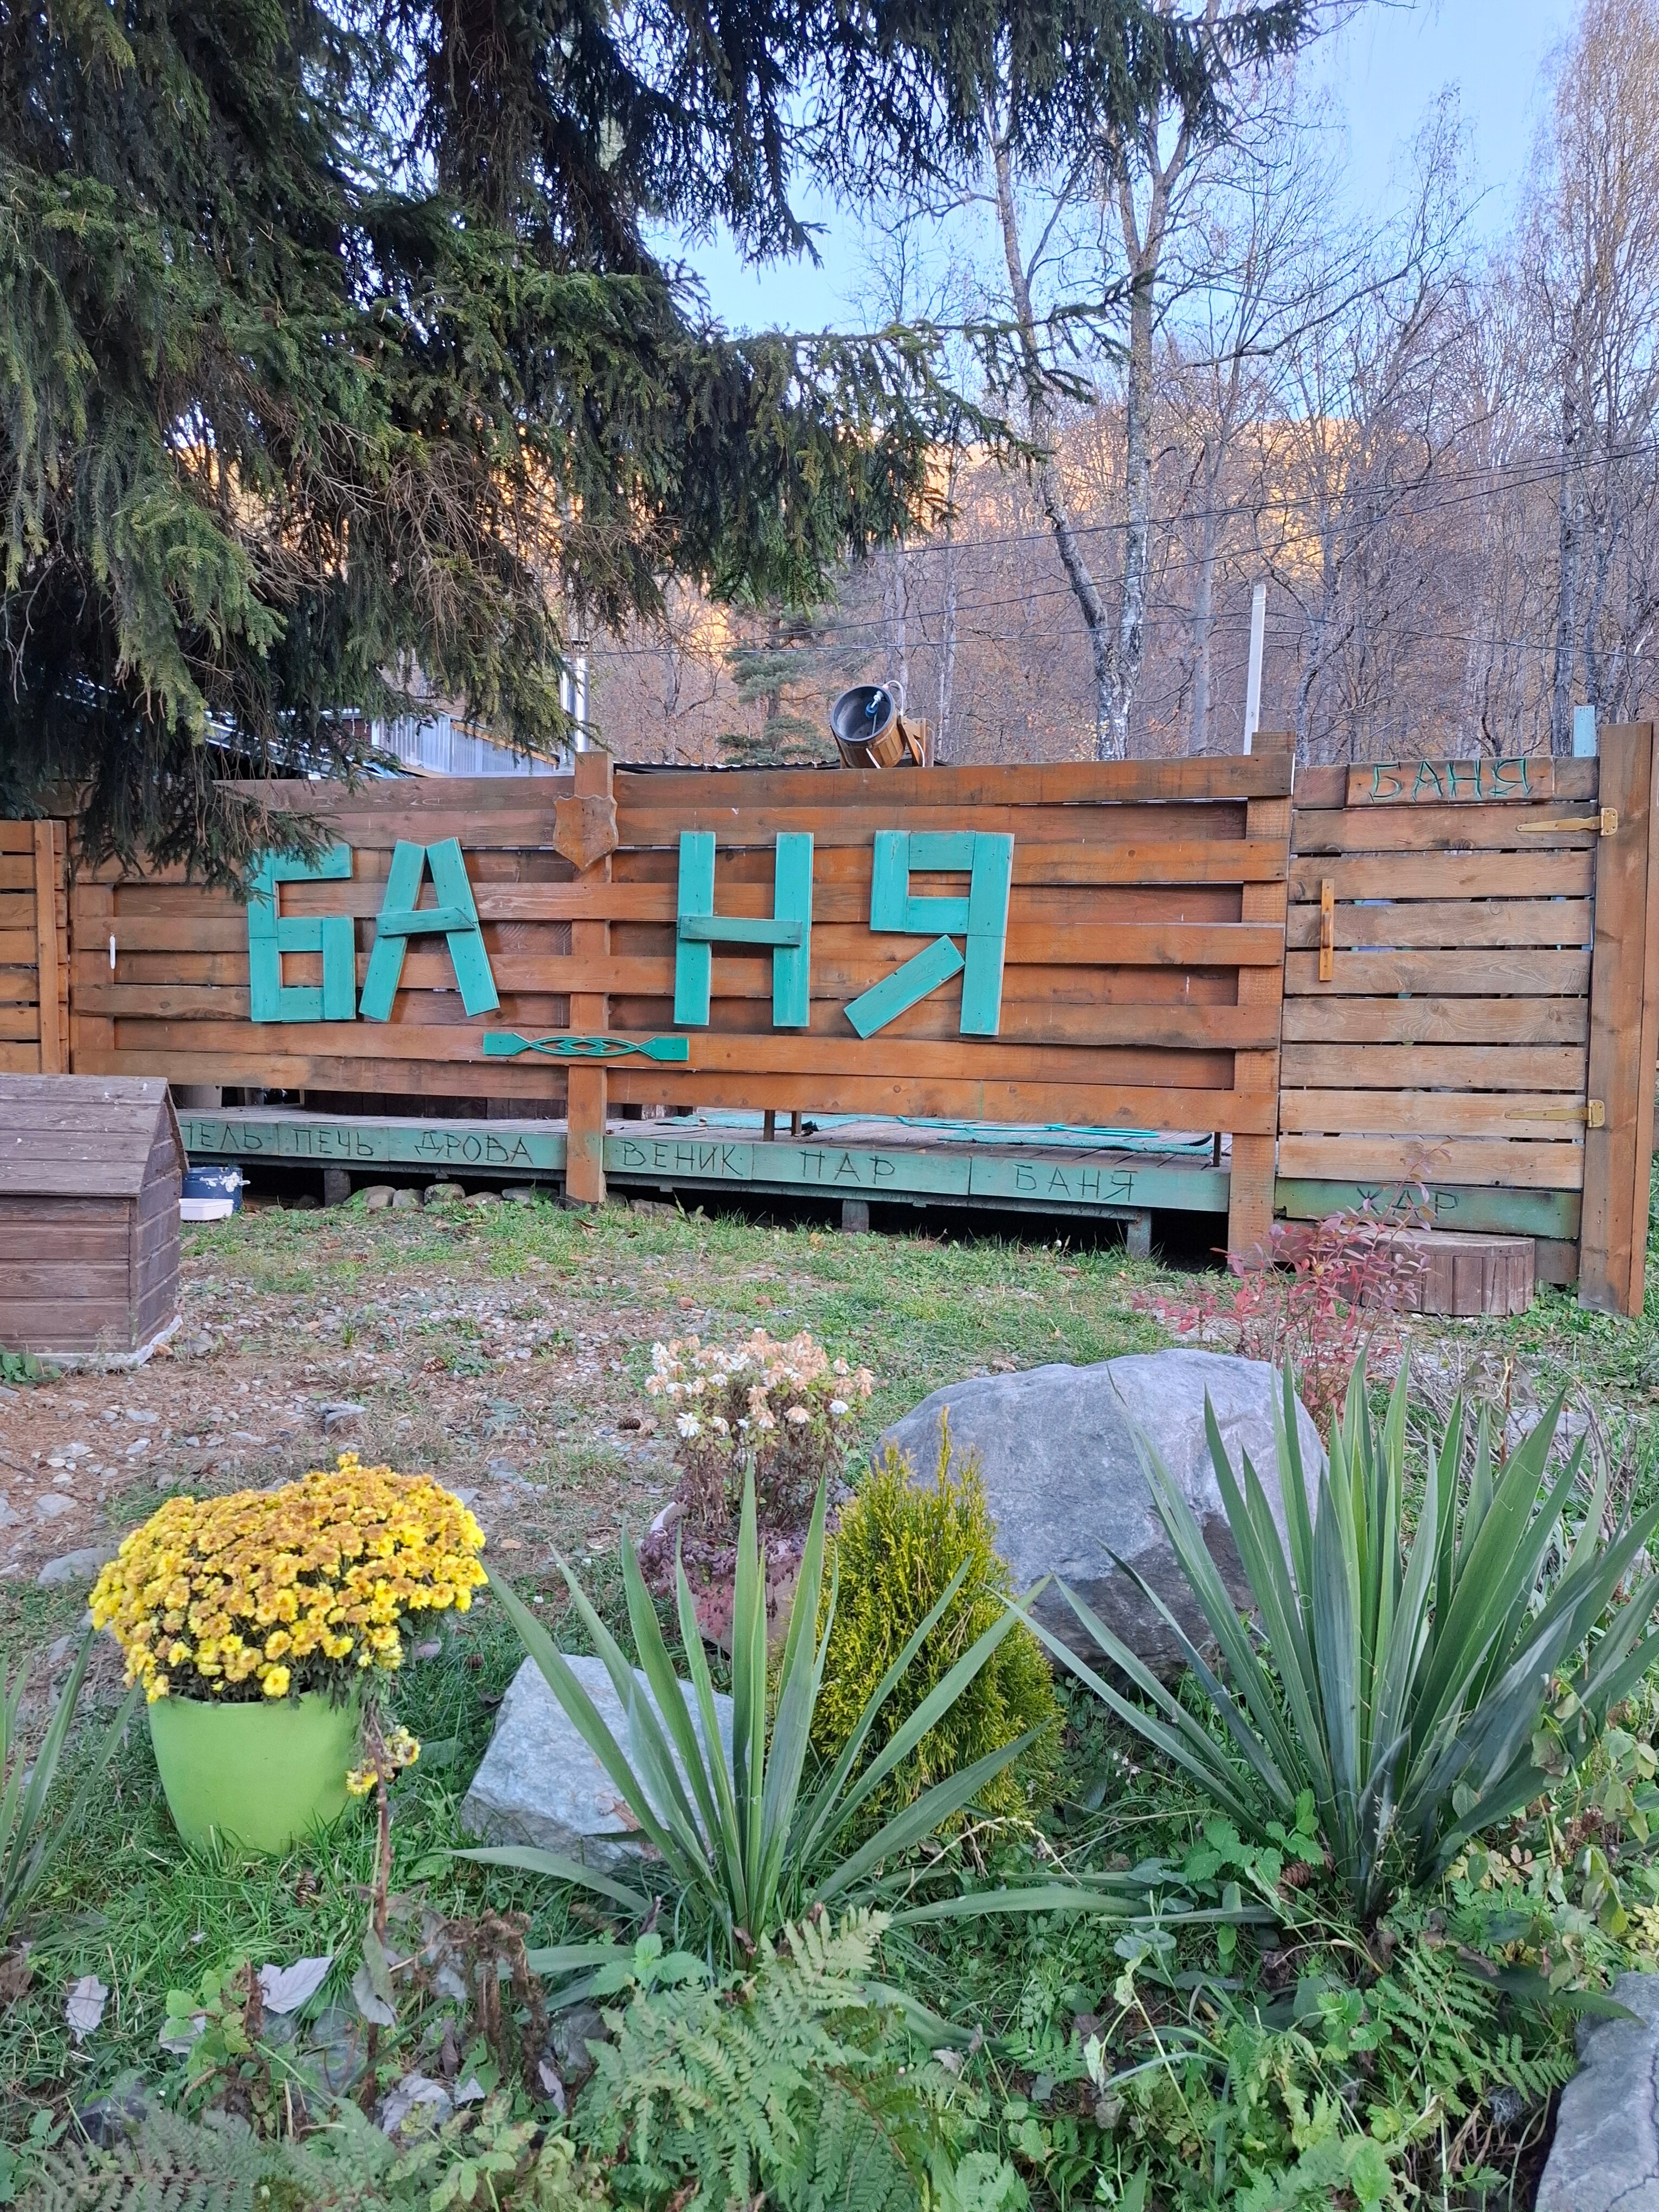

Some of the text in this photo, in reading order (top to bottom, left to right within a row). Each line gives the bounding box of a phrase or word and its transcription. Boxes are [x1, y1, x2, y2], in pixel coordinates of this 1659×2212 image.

[1368, 758, 1534, 802] БАНЯ
[247, 829, 1015, 1040] БАНЯ
[291, 1128, 375, 1156] ПЕЧЬ
[414, 1129, 534, 1165] ДРОВА
[618, 1140, 744, 1176] ВЕНИК
[798, 1149, 896, 1185] ПАР
[1013, 1163, 1139, 1202] БАНЯ
[1356, 1186, 1459, 1220] ЖАР
